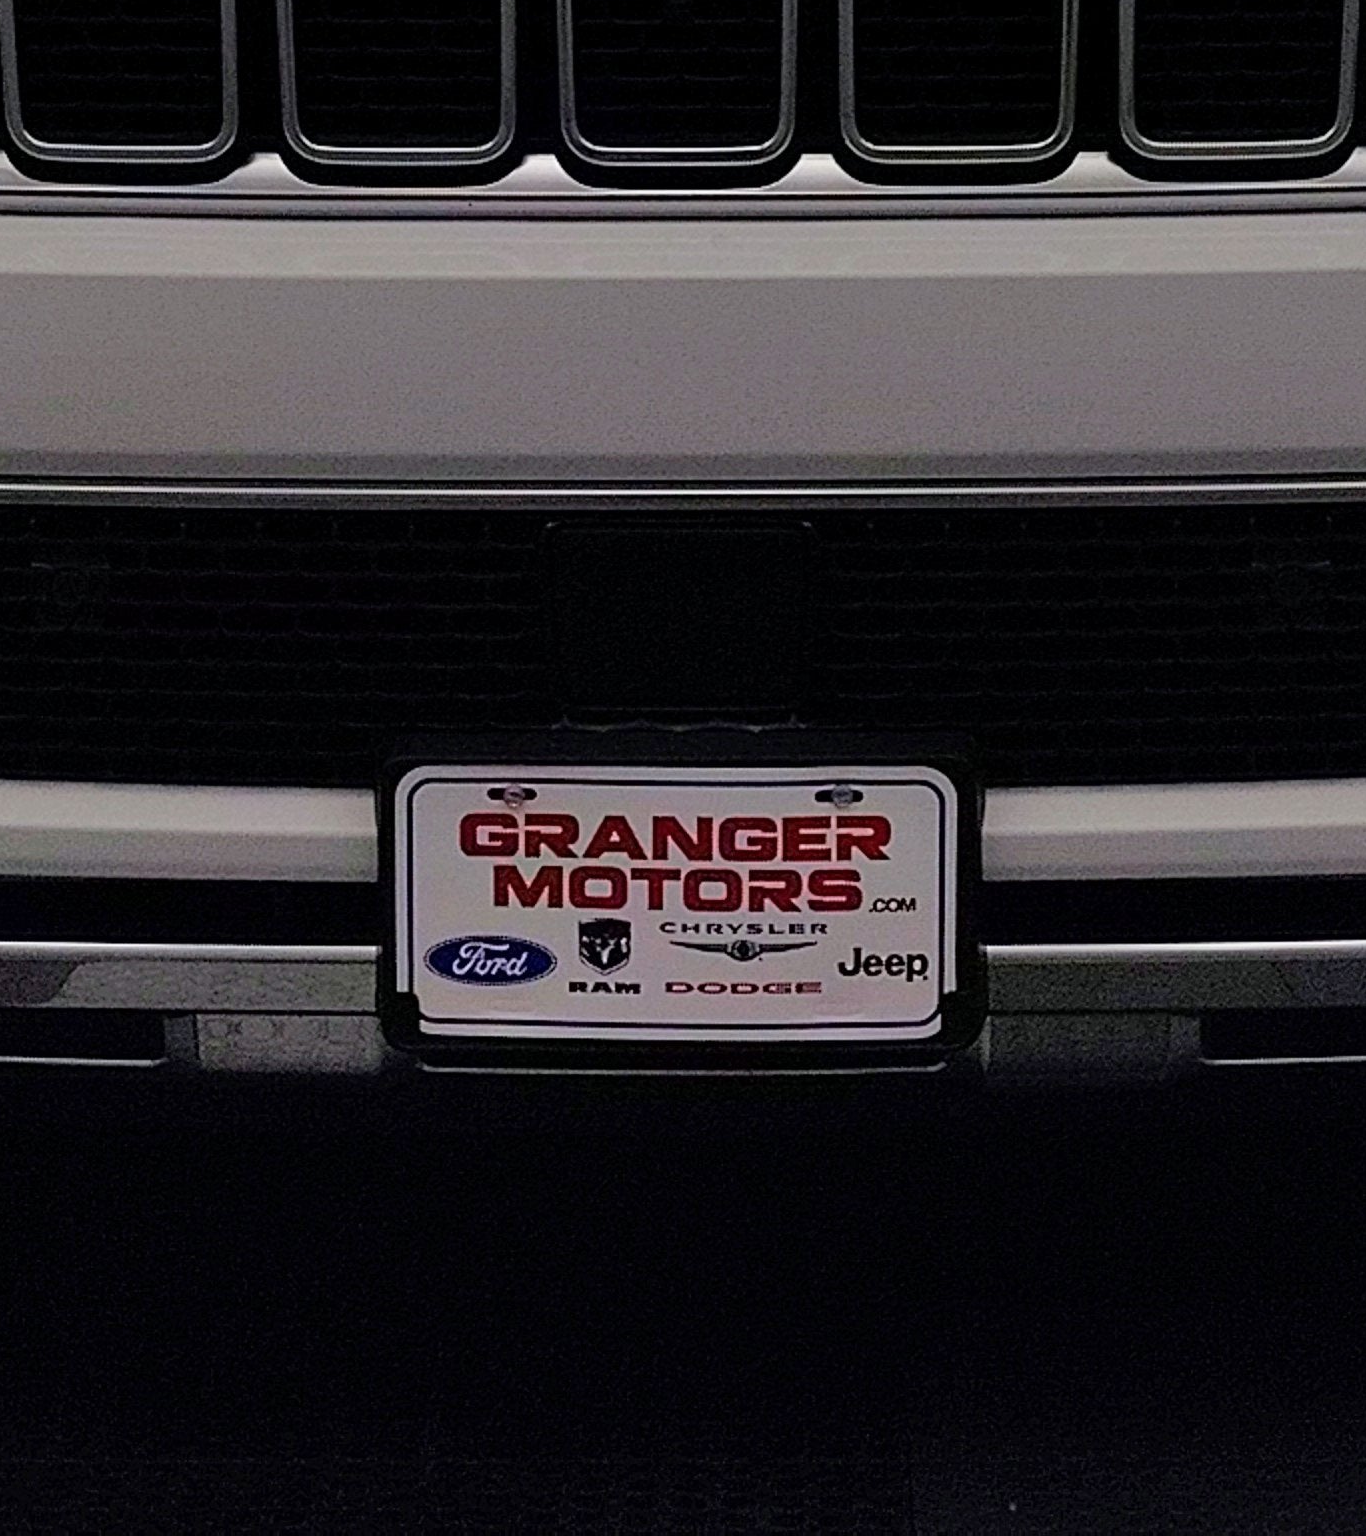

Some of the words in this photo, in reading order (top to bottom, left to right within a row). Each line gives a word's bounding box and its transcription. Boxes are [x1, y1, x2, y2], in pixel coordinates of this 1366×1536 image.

[458, 811, 893, 862] GRANGER
[492, 864, 865, 914] MOTORS
[868, 896, 918, 913] .COM
[658, 921, 830, 936] CHRYSLER
[451, 942, 529, 978] Ford
[837, 946, 929, 983] Jeep
[568, 980, 642, 995] RAM
[664, 981, 824, 995] DODGE
